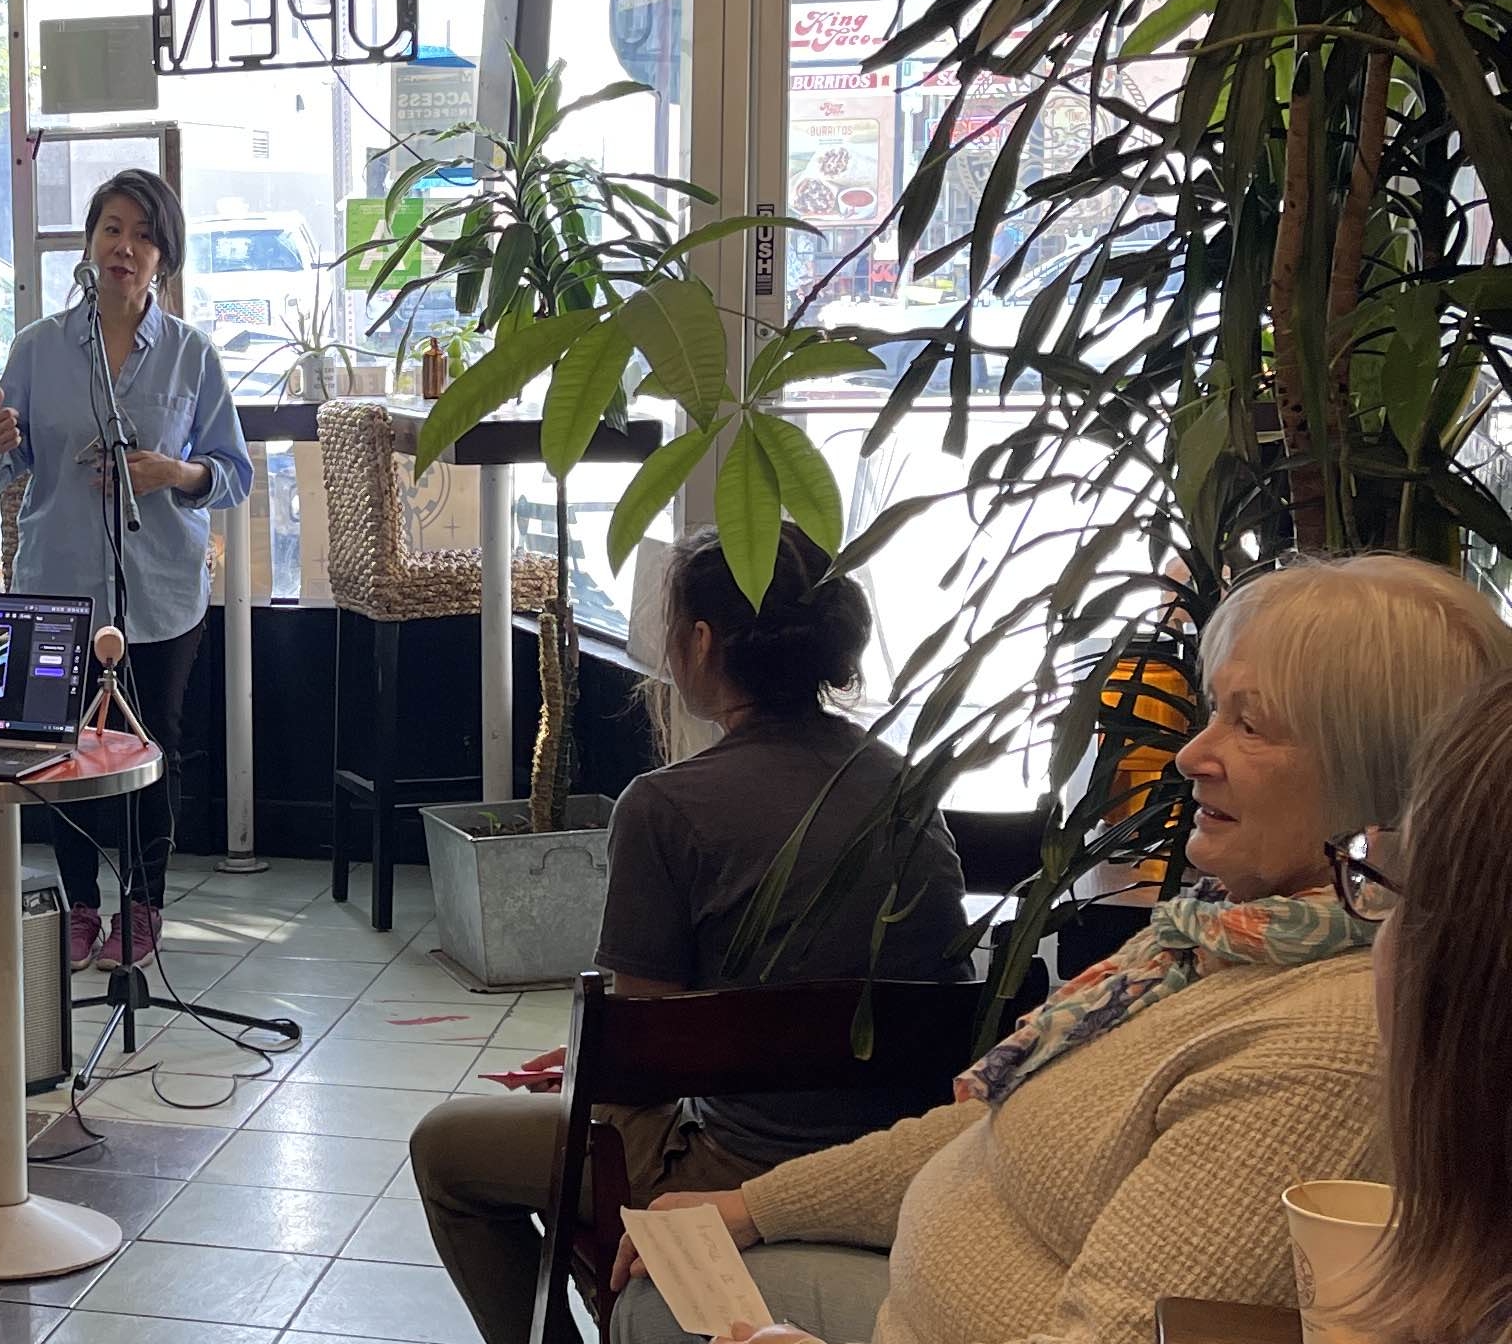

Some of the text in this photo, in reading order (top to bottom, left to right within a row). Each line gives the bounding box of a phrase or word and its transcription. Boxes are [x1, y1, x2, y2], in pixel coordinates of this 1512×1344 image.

[795, 11, 869, 35] King
[811, 28, 871, 52] Taco
[791, 74, 871, 90] BURRITOS
